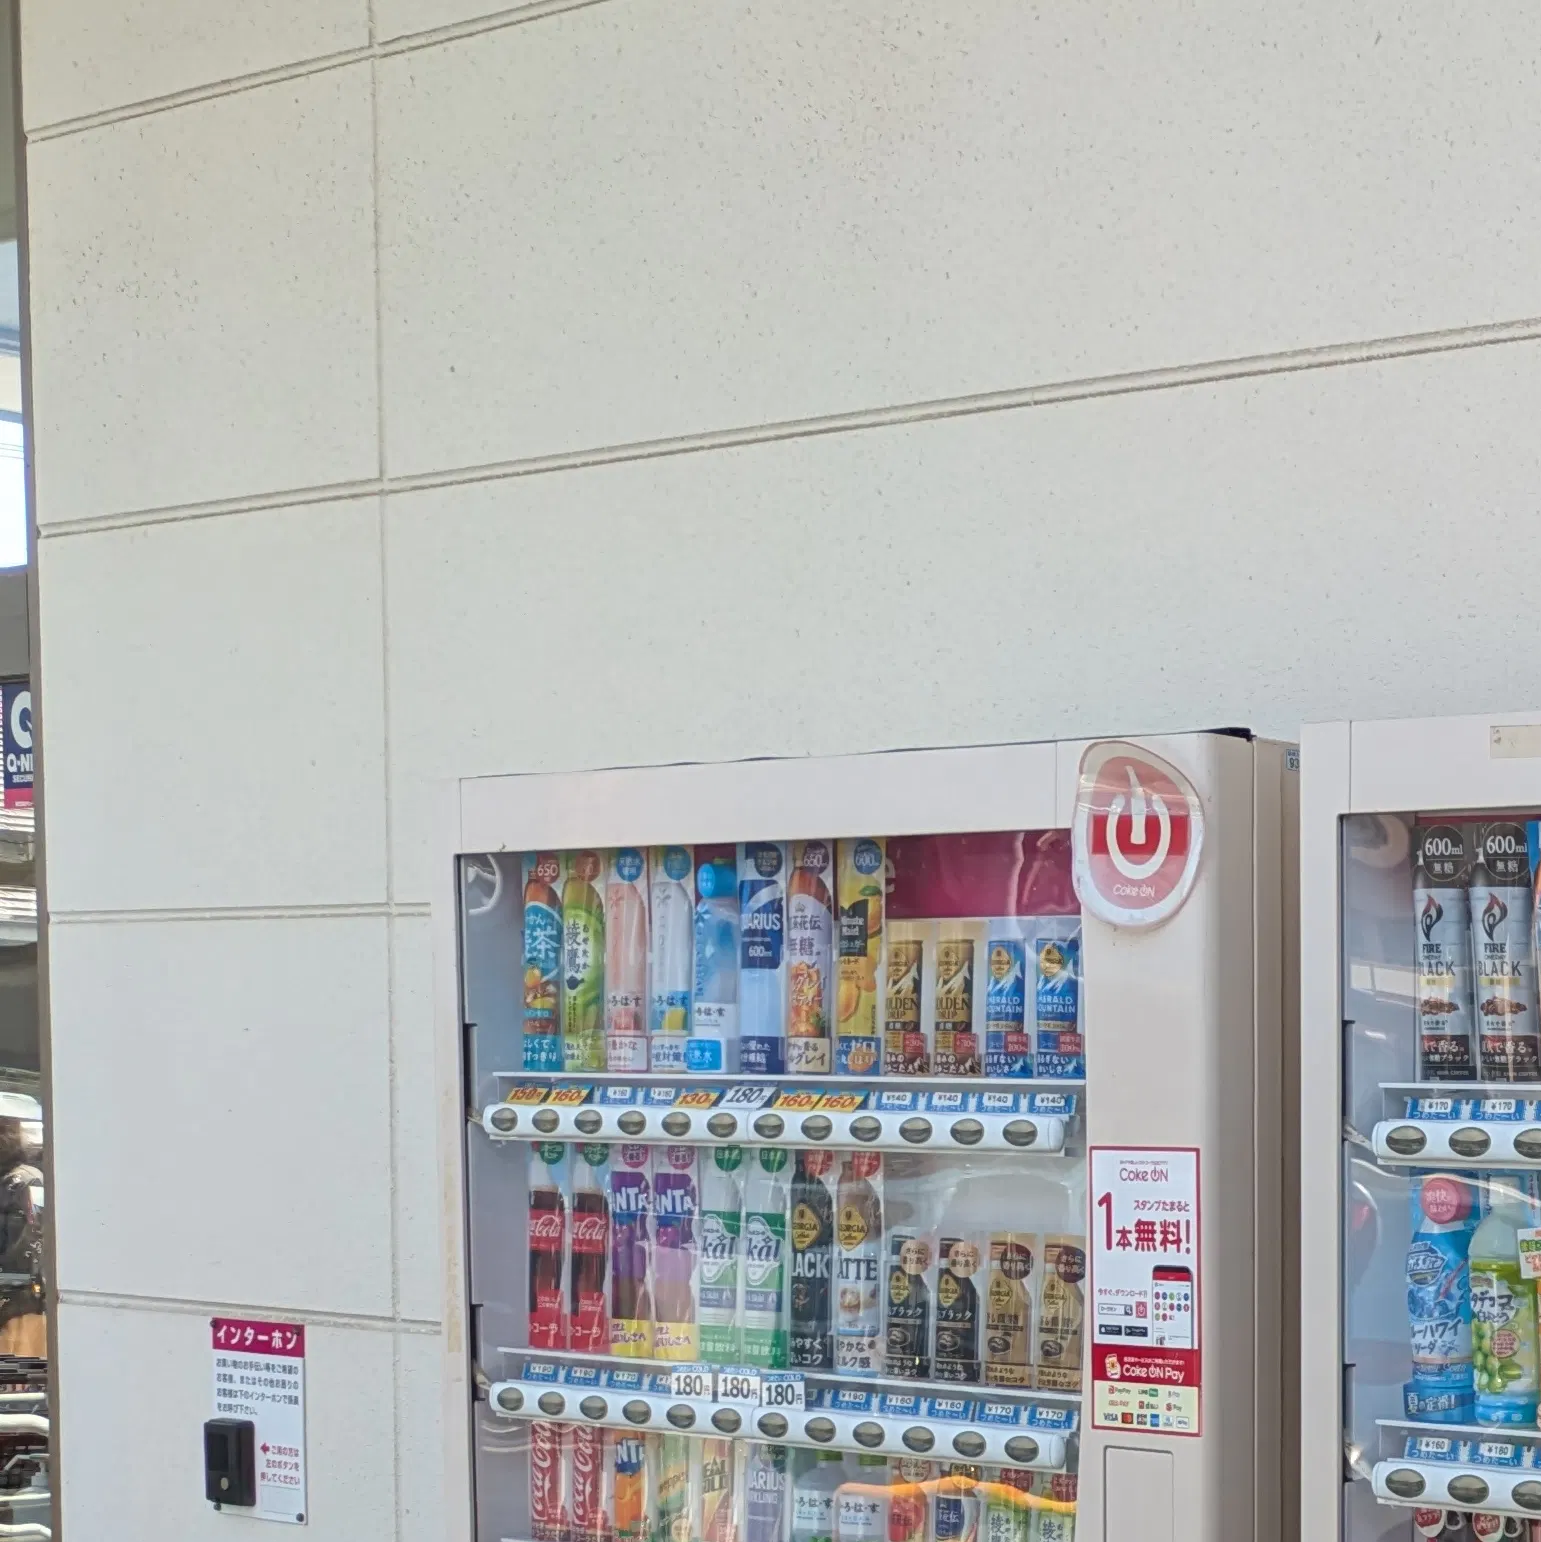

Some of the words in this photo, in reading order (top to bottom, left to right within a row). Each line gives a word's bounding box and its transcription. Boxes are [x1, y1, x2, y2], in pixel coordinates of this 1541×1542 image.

[1424, 837, 1464, 856] 600ml
[1486, 834, 1528, 854] 600ml
[1422, 943, 1442, 954] FIRE
[1484, 943, 1506, 954] FIRE
[1120, 1167, 1148, 1182] Coke
[1134, 1200, 1190, 1212] スタンプたまると
[216, 1325, 298, 1349] インターホン
[1123, 1364, 1149, 1378] Coke
[1165, 1369, 1185, 1383] Pay
